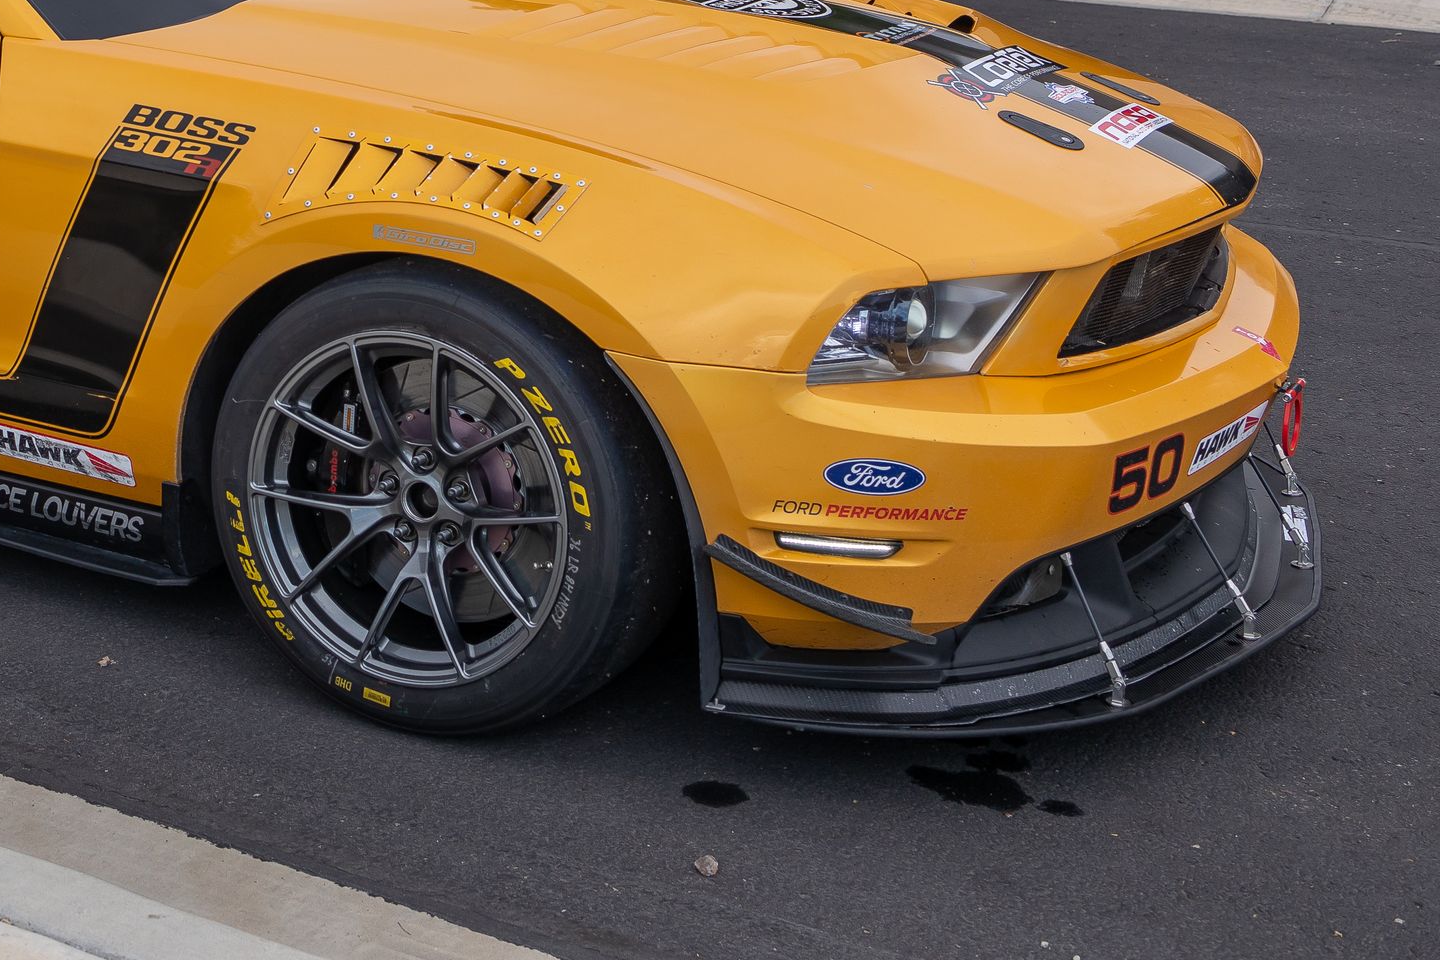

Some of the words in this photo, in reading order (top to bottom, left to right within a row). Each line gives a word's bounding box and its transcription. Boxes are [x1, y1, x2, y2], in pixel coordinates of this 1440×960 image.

[122, 104, 257, 146] BOSS
[113, 129, 211, 165] 302
[493, 357, 526, 380] P
[521, 386, 592, 517] ZERO
[1192, 417, 1246, 466] HAWK
[843, 462, 906, 489] Ford
[1107, 431, 1185, 516] 50
[31, 492, 145, 542] LOUVERS
[771, 499, 822, 516] FORD
[825, 504, 969, 521] PERFORMANCE
[334, 675, 352, 692] DHB
